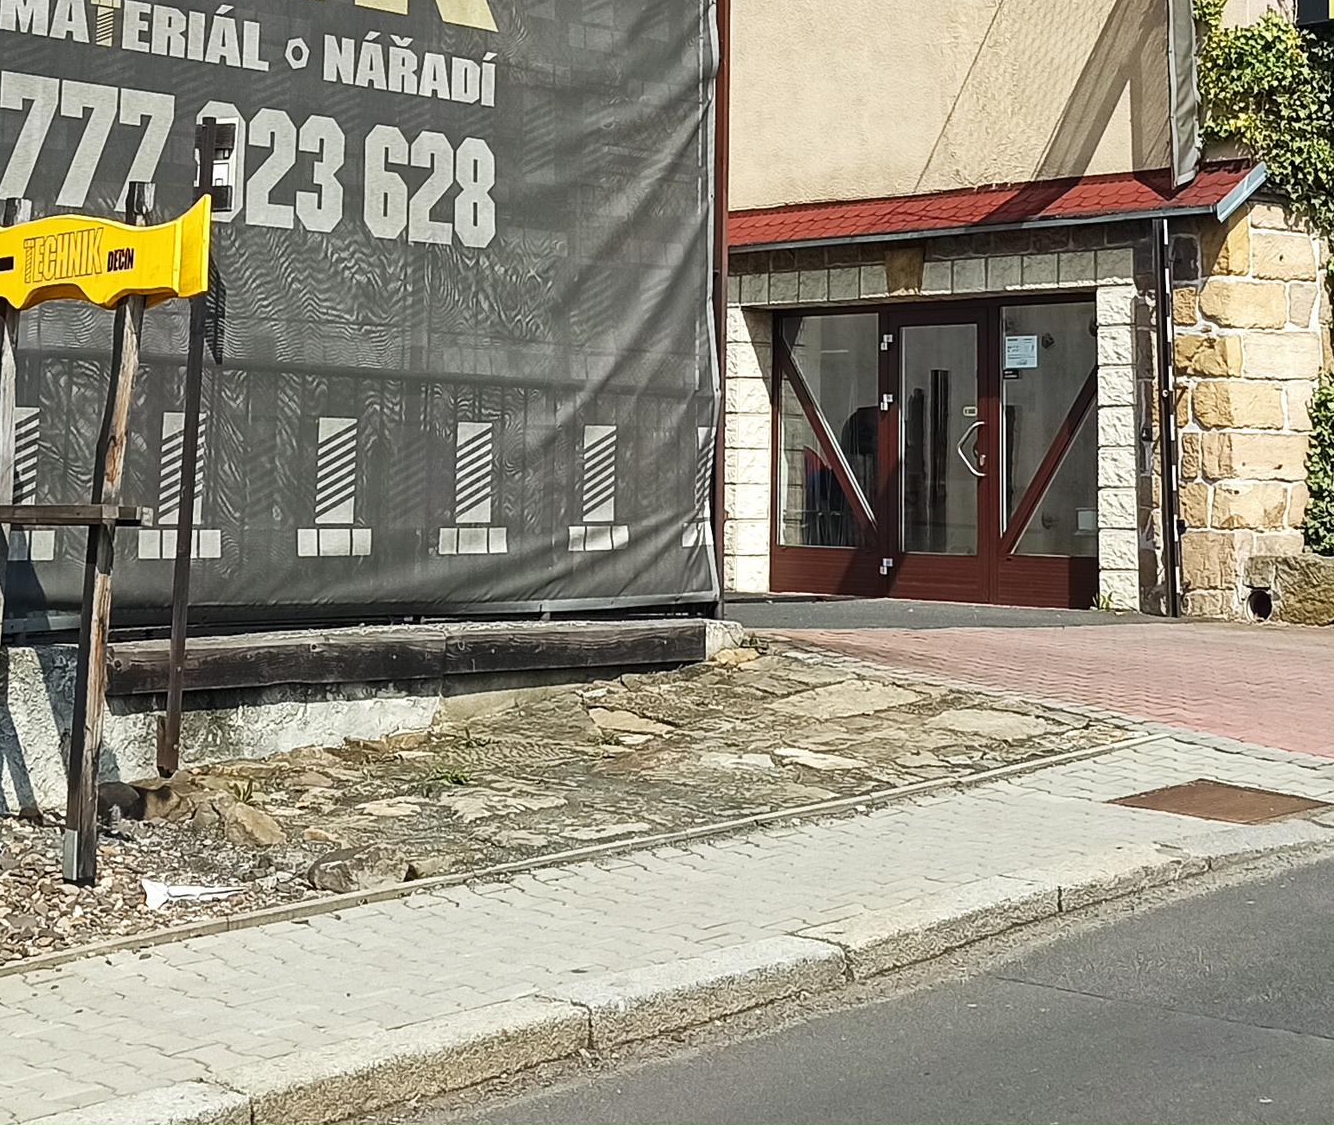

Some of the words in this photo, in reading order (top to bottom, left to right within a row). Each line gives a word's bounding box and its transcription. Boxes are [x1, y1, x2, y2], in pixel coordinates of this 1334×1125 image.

[322, 32, 497, 107] NÁŘADÍ
[363, 124, 496, 248] 628
[23, 226, 104, 284] TECHNIK
